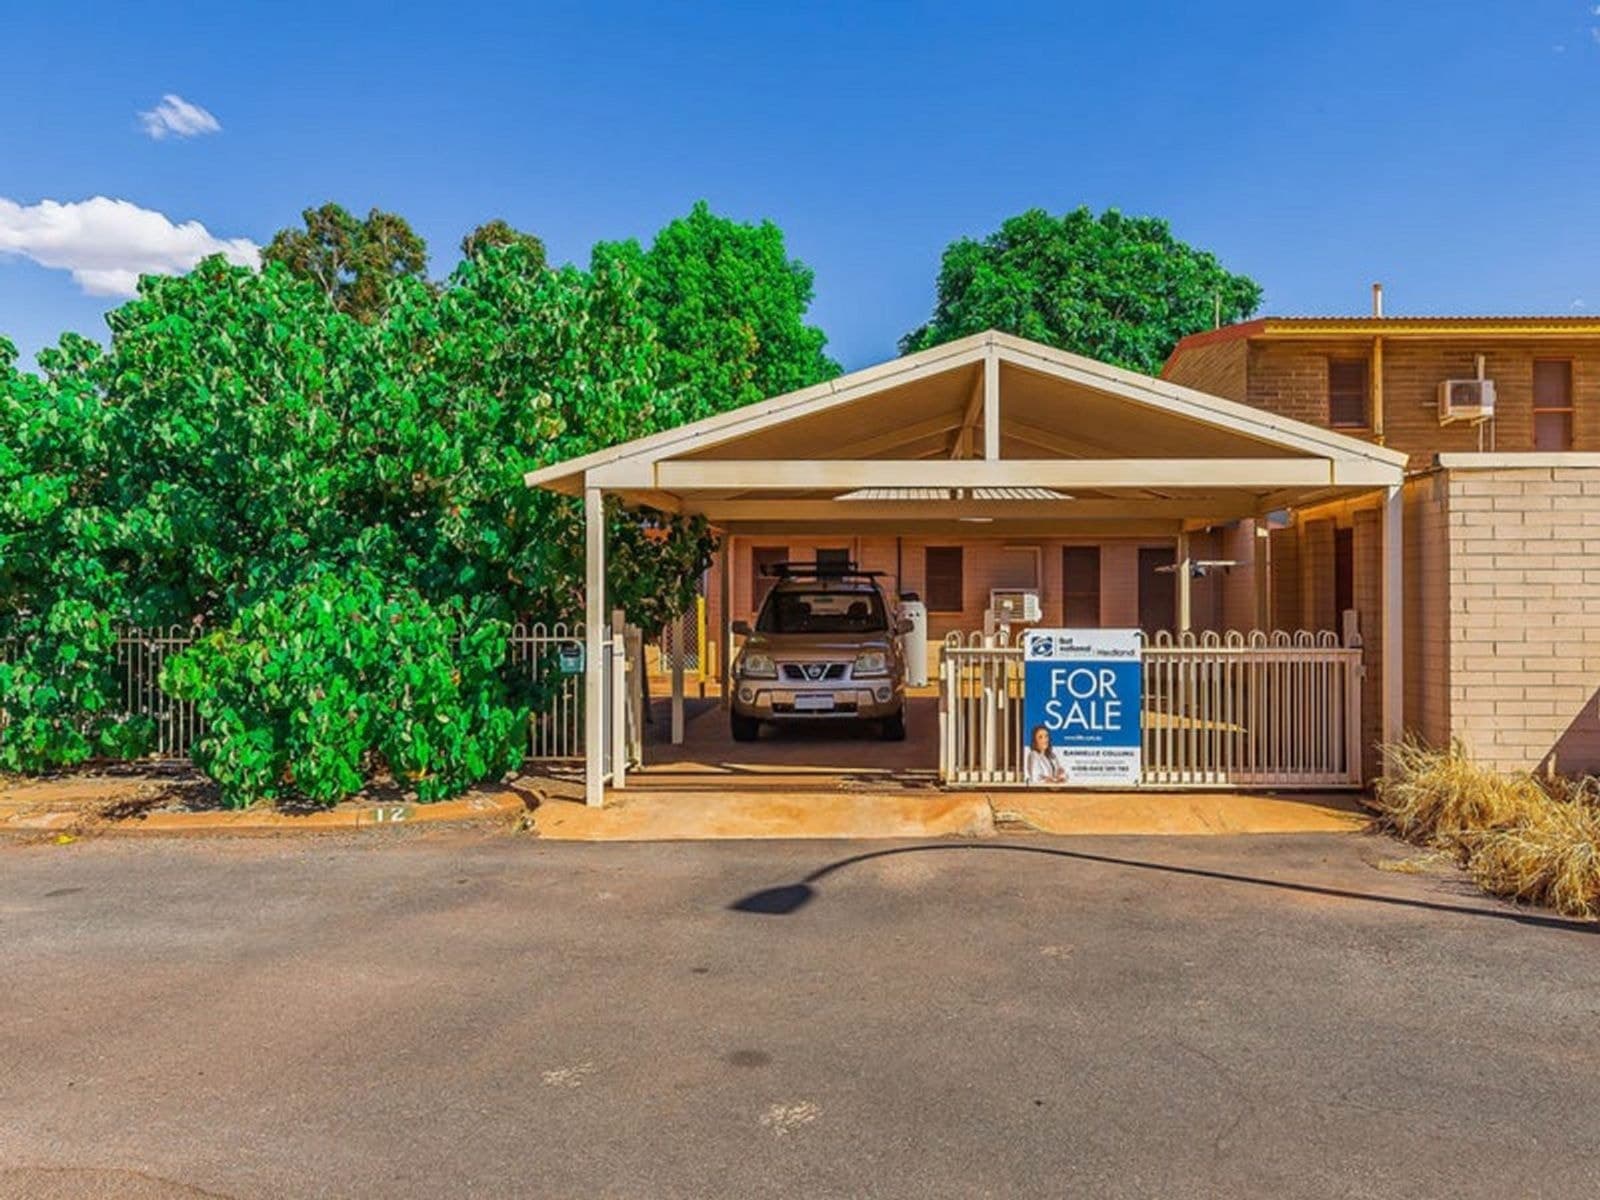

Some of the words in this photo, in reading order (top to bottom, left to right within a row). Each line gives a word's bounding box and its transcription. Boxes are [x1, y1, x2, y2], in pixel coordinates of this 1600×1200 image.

[1051, 668, 1118, 699] FOR
[1043, 700, 1122, 730] SALE
[377, 807, 405, 822] 12
